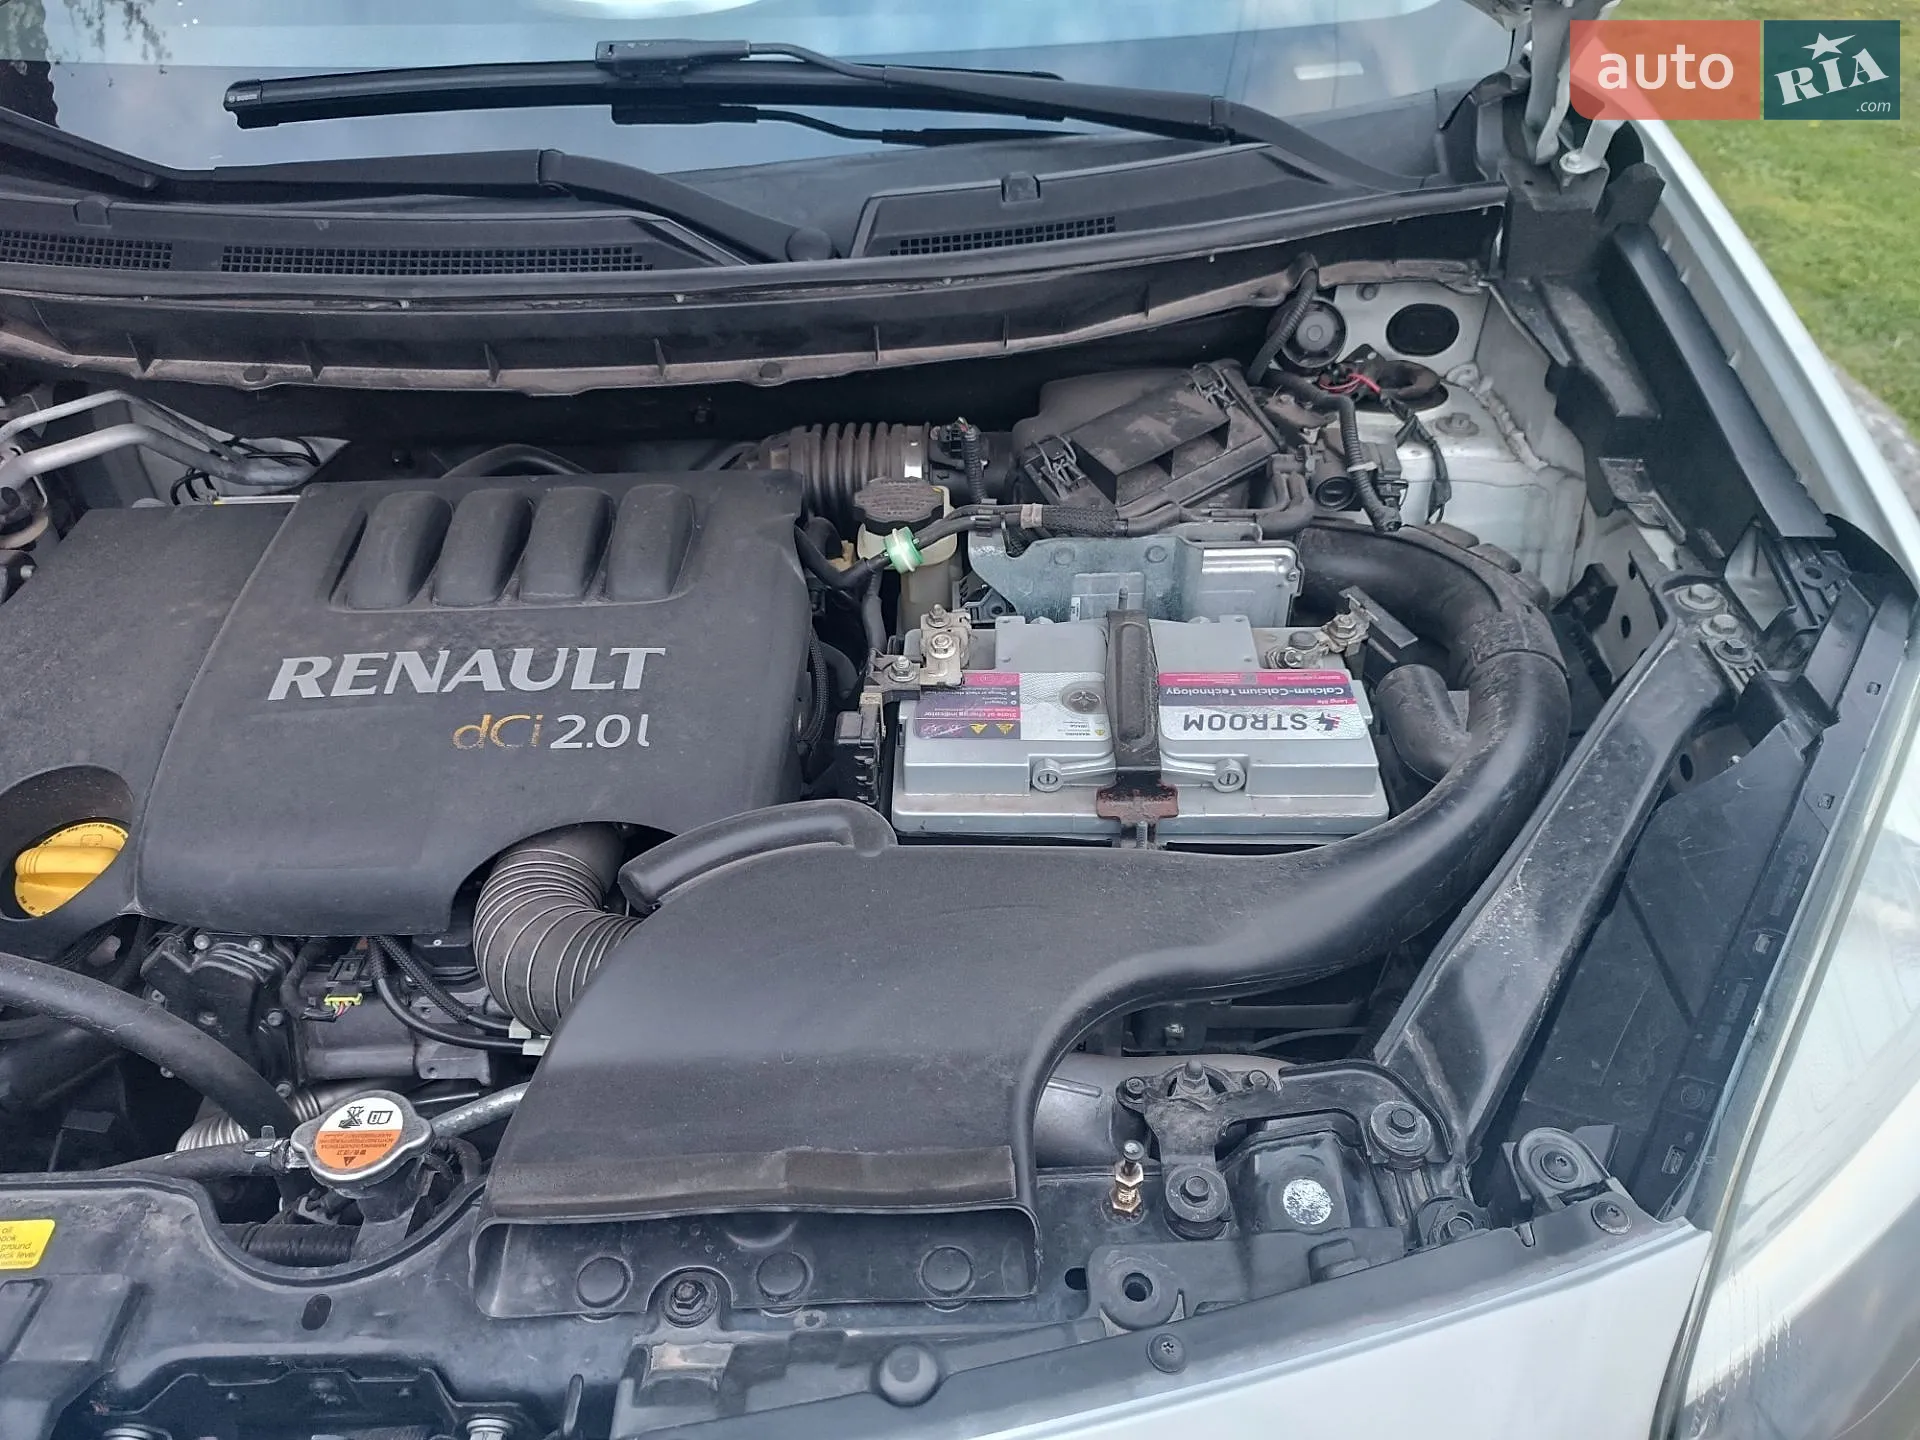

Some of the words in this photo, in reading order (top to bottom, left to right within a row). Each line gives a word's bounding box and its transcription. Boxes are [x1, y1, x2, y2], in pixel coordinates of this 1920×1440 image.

[267, 647, 667, 701] RENAULT
[1166, 685, 1236, 697] Technology
[1237, 686, 1344, 696] Calcium-Calcium
[1183, 713, 1308, 731] STROOM
[452, 712, 545, 751] dCi
